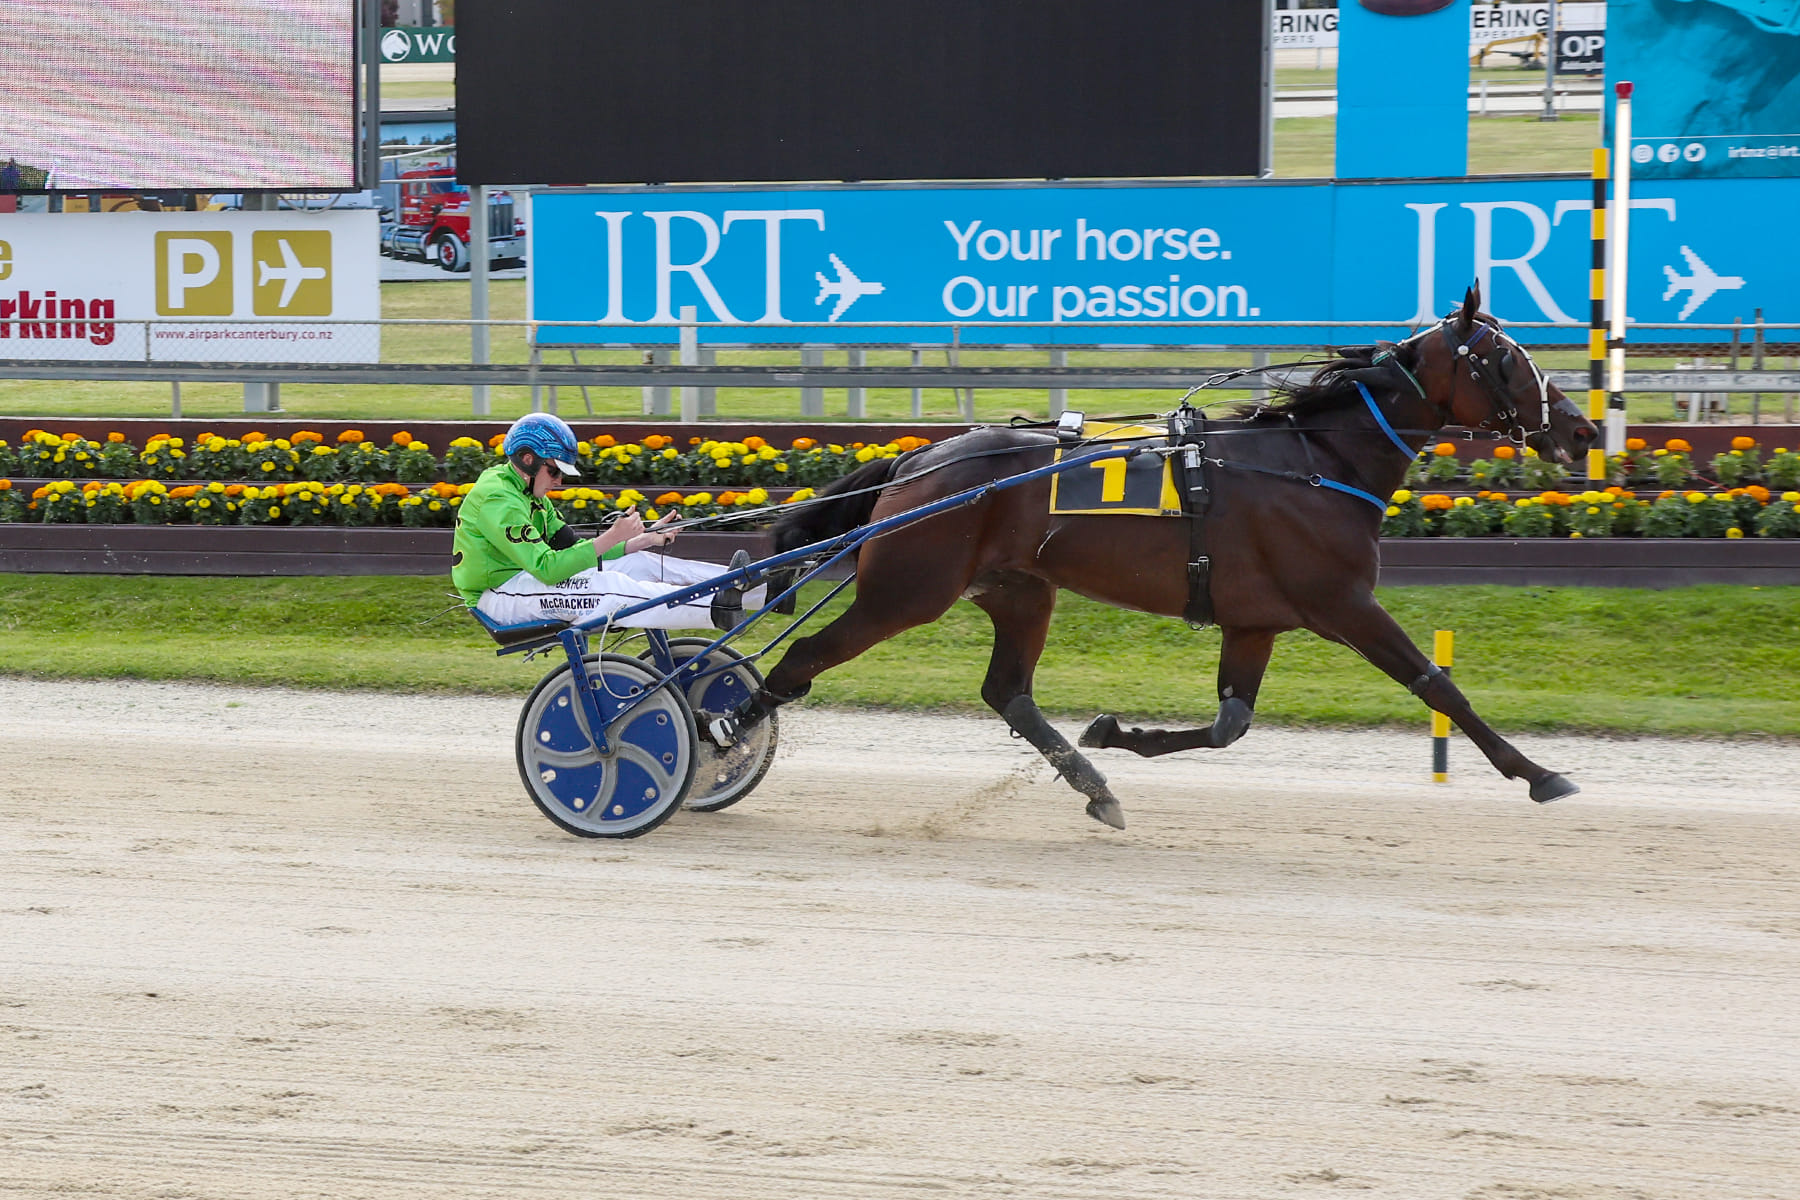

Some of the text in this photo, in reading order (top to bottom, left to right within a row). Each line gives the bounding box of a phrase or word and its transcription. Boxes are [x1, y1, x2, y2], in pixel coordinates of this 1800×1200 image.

[1473, 9, 1549, 28] ERING
[943, 218, 1232, 261] Your horse.
[1403, 197, 1677, 323] IRT
[167, 238, 221, 309] P
[594, 208, 826, 324] IRT
[942, 274, 1261, 321] Our passion.
[155, 329, 333, 342] www.airparkcanterbury.co.nz
[1090, 445, 1130, 503] 1
